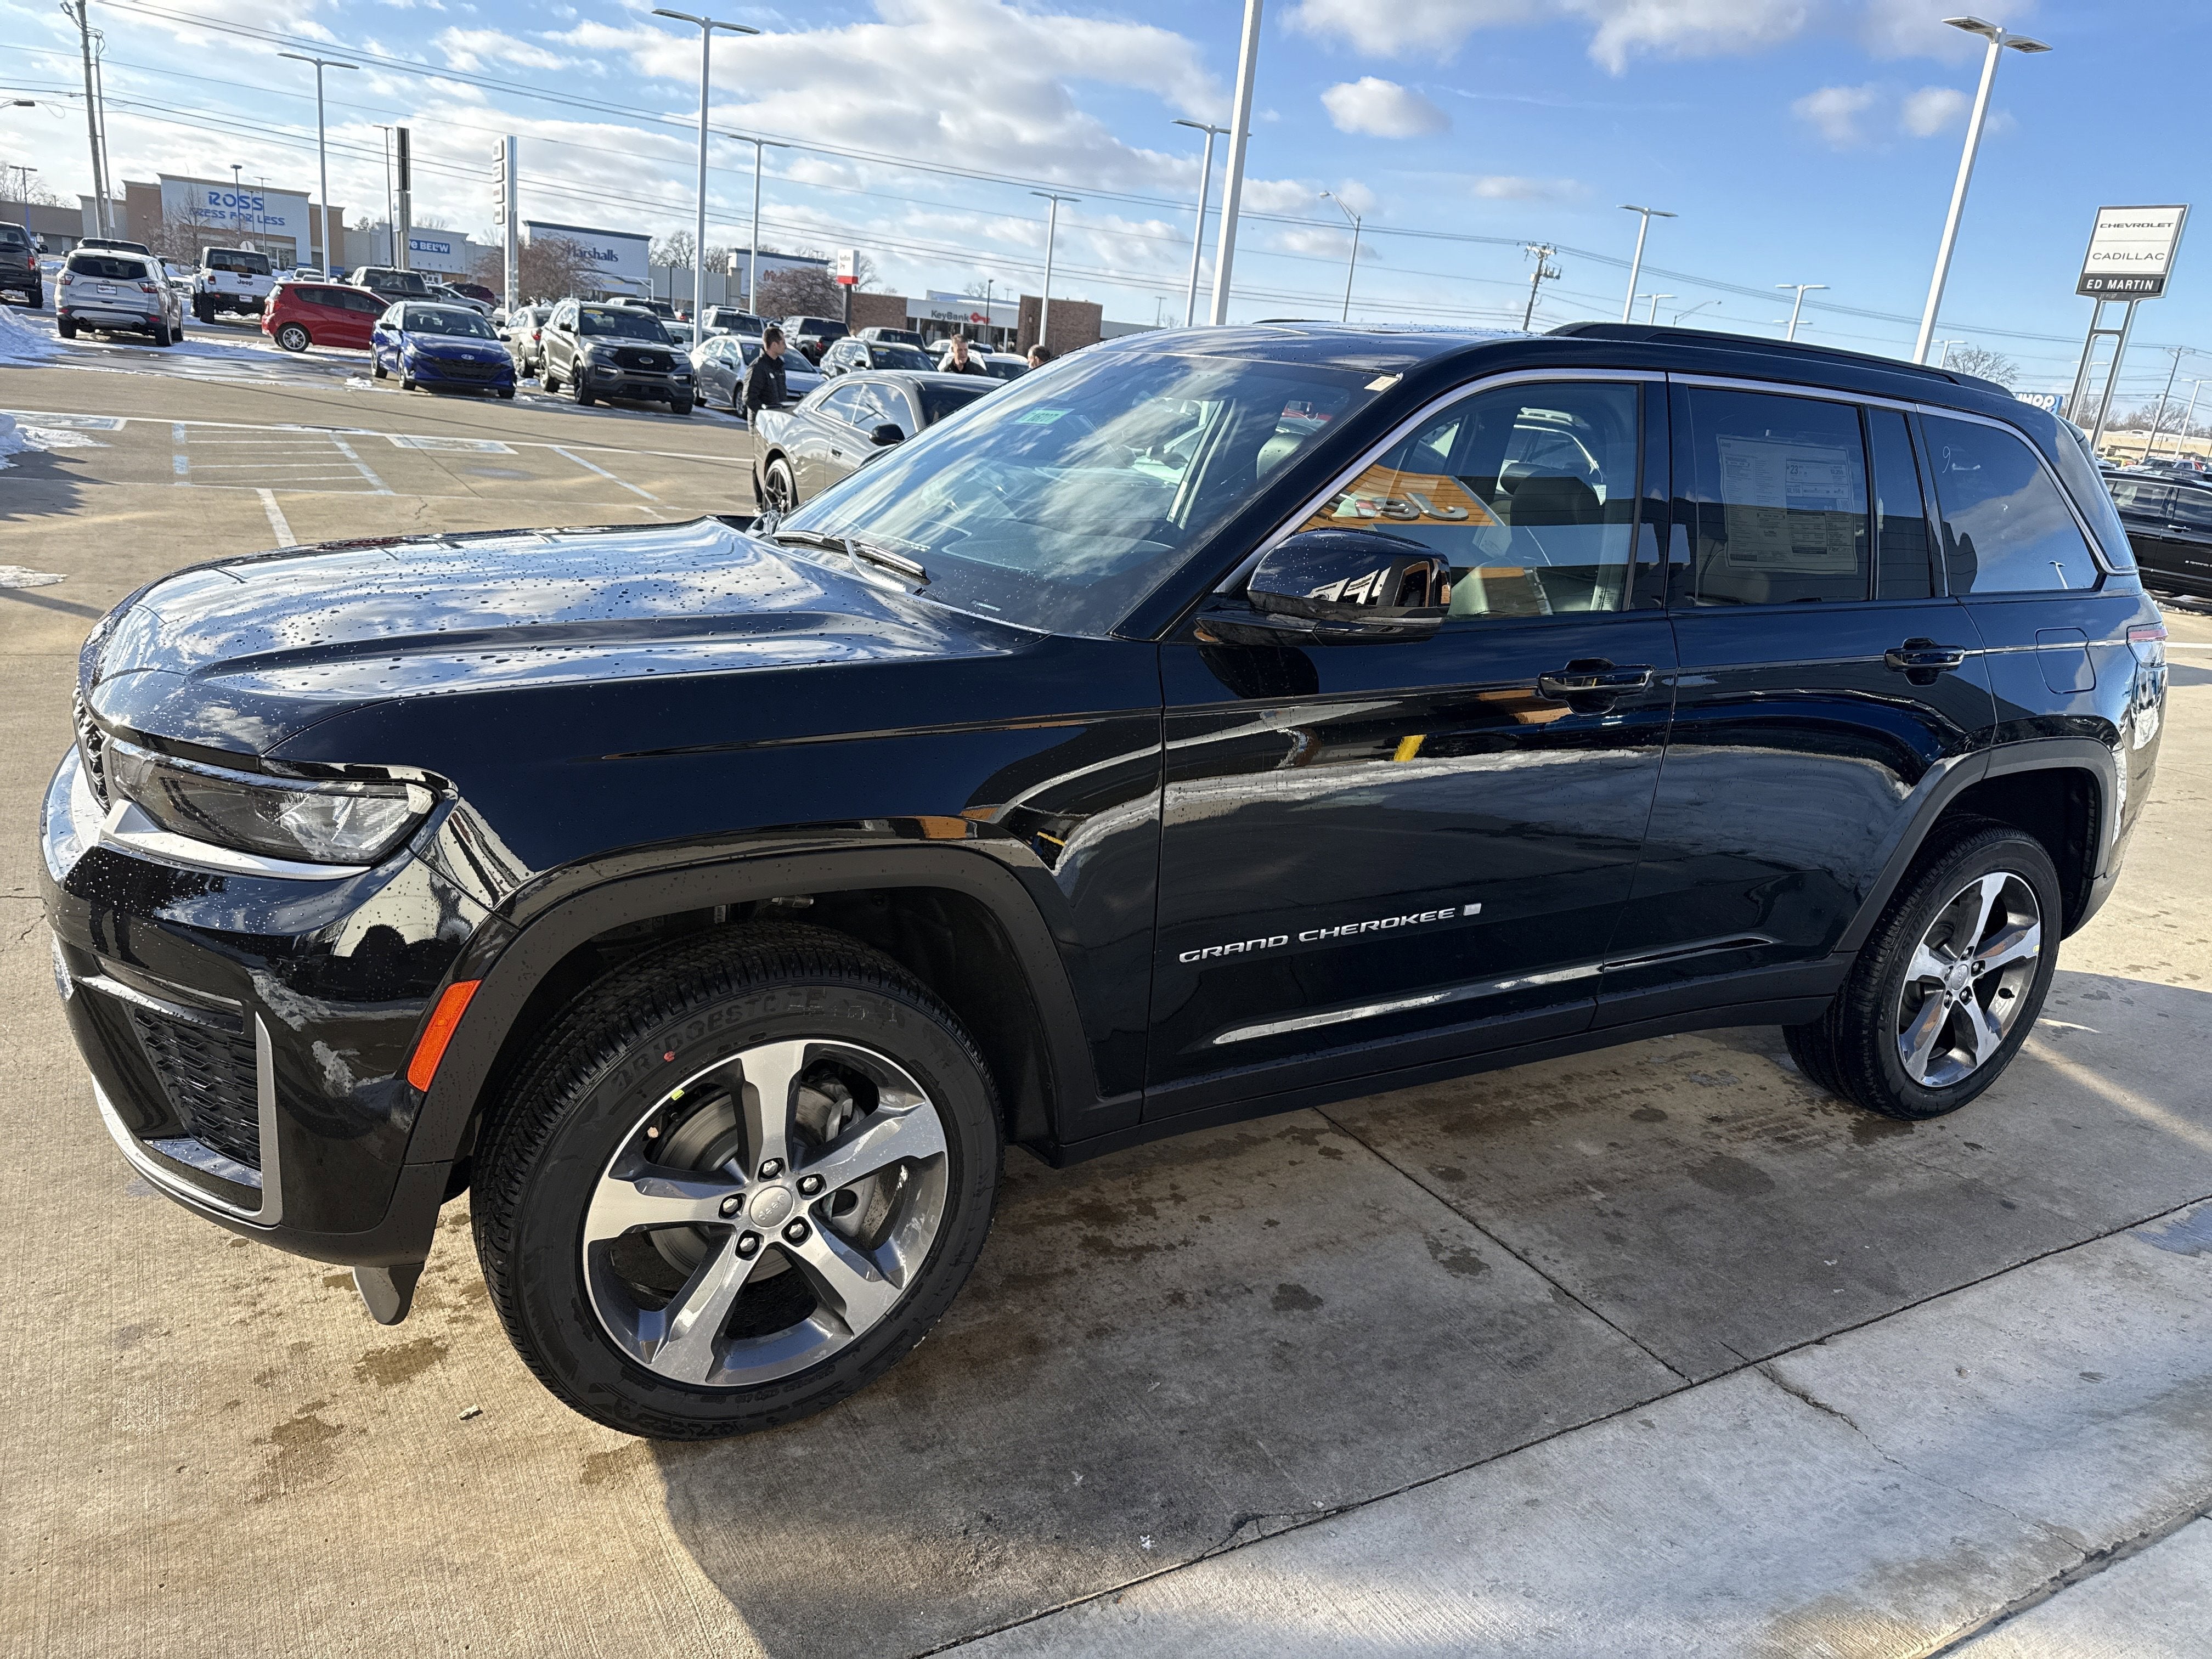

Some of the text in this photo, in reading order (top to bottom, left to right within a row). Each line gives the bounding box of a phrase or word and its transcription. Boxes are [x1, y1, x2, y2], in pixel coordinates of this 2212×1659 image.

[208, 191, 262, 211] ROSS
[230, 212, 252, 222] FOR
[257, 215, 285, 225] LESS
[420, 242, 448, 252] BELOW
[567, 245, 618, 262] Marshalls
[2086, 279, 2154, 290] ED MARTIN
[931, 310, 969, 321] KeyBank
[1790, 465, 1798, 475] 23
[1179, 908, 1455, 963] GRAND CHEROKEE
[758, 1193, 786, 1221] Jeep
